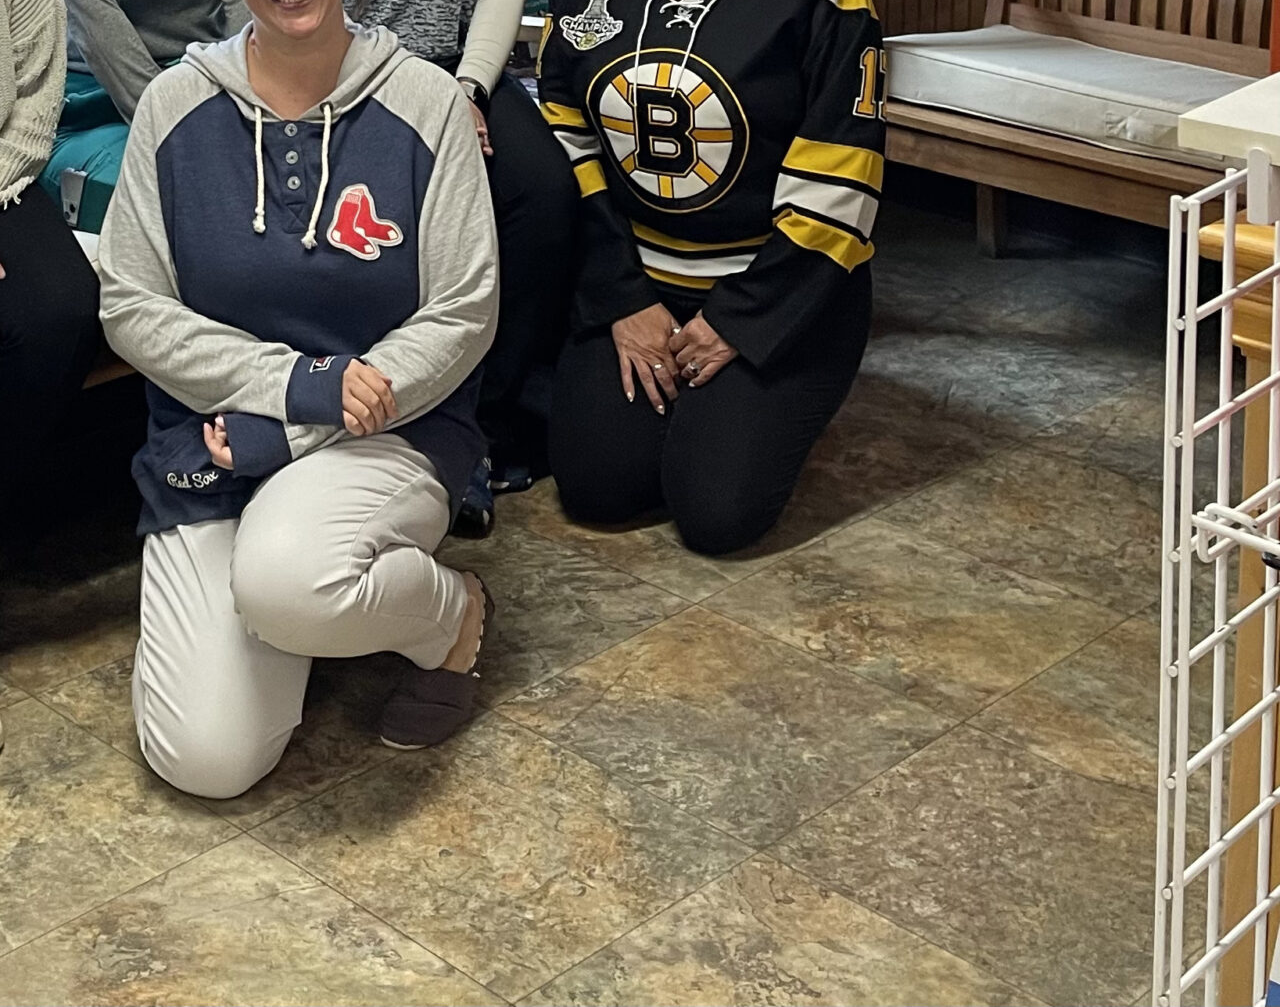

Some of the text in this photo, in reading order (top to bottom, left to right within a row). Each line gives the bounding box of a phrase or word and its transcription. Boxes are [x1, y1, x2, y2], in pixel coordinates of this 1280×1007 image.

[563, 17, 622, 33] CHAMPIONS
[628, 83, 699, 177] B
[167, 471, 219, 488] Red Sox
